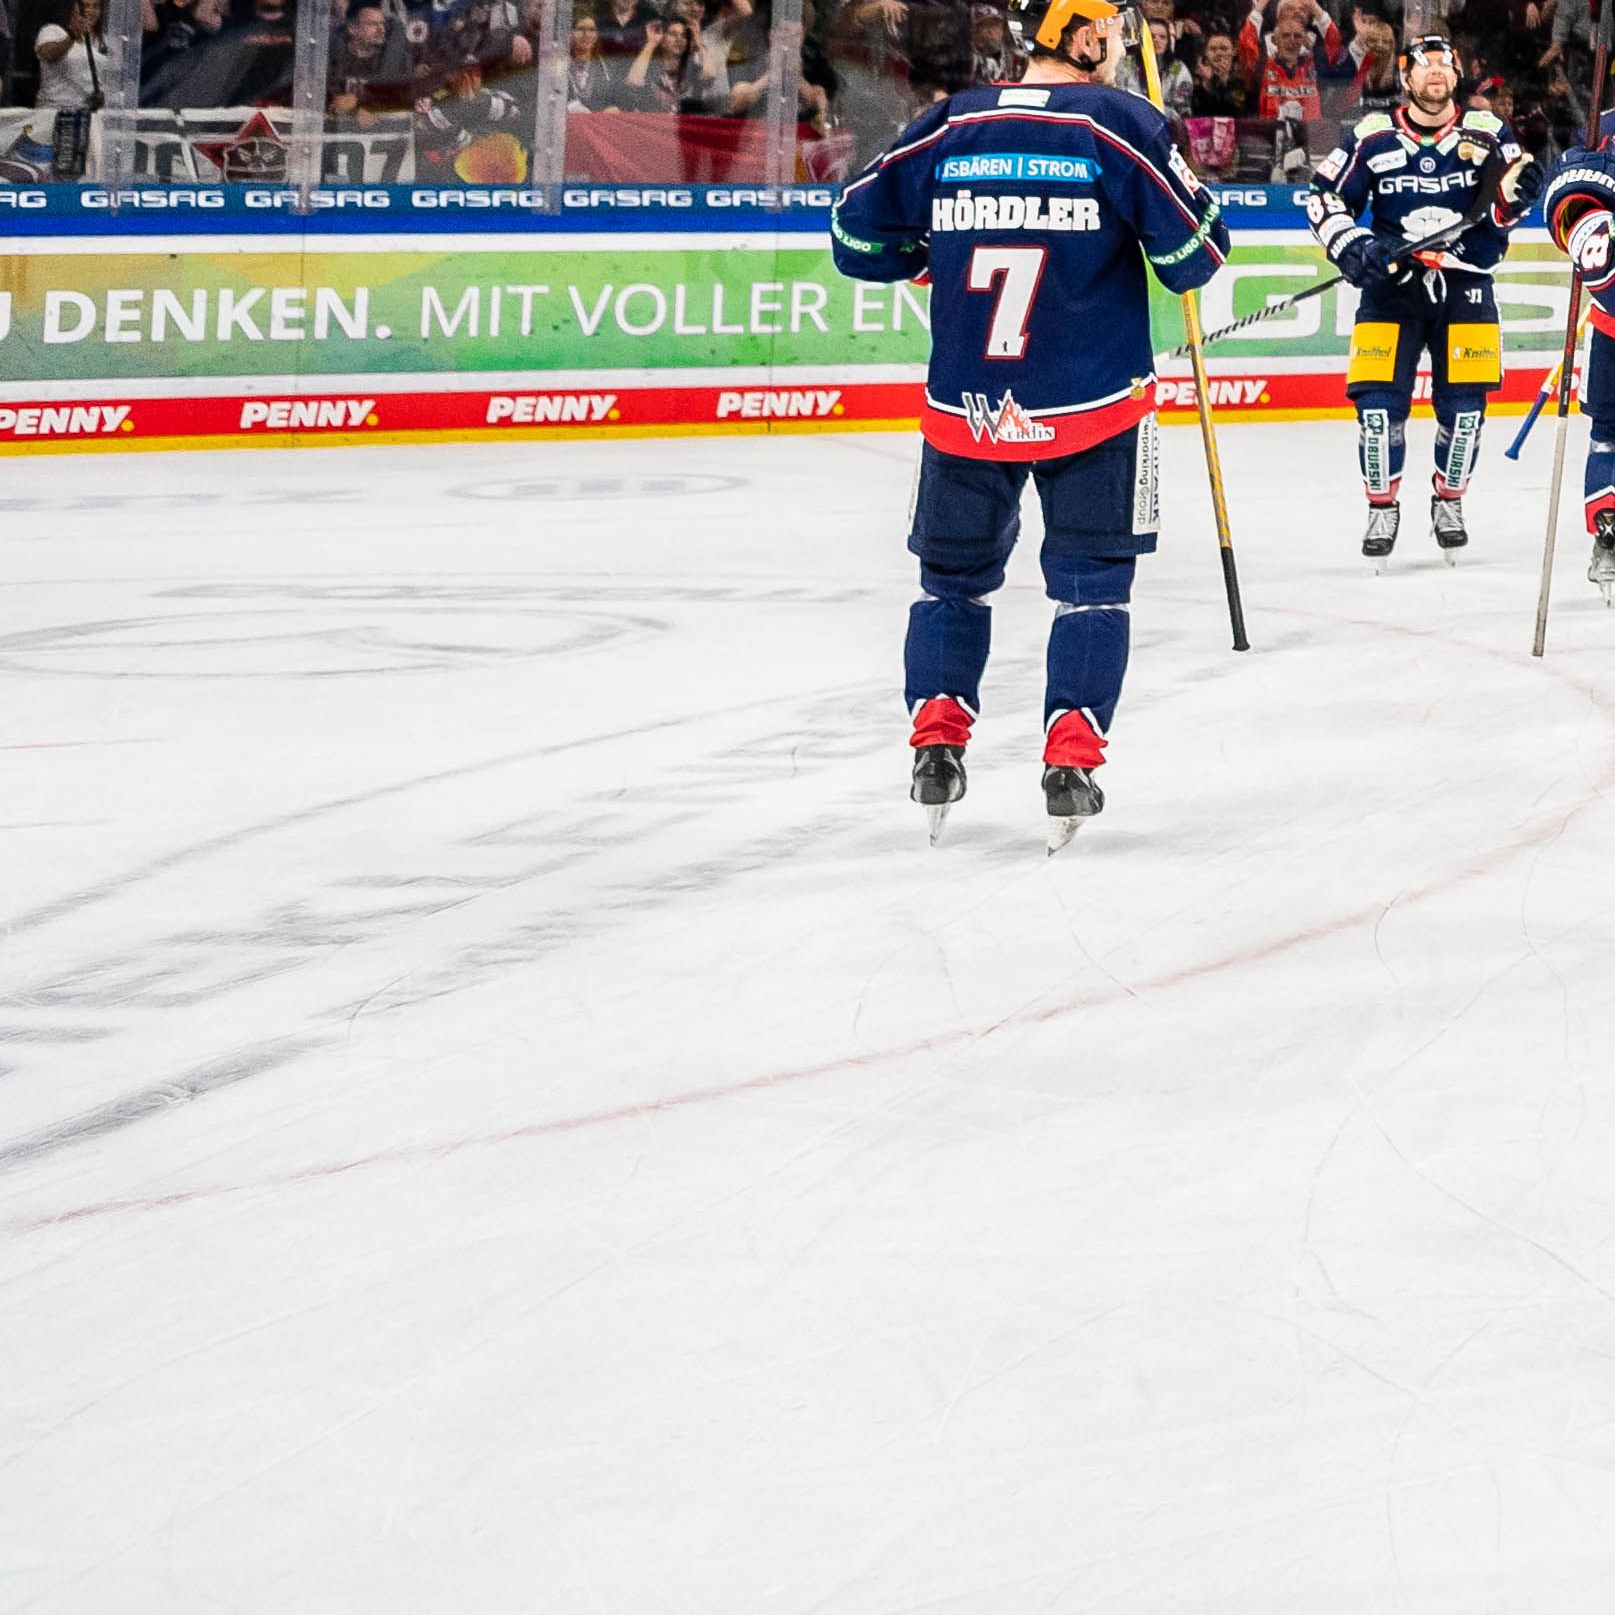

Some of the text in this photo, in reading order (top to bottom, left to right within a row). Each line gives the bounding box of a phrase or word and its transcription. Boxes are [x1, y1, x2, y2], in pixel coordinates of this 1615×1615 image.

[1027, 160, 1088, 180] STROM
[81, 188, 833, 210] GASAG GASAG GASAG GASAG GASAG
[933, 189, 1101, 231] HÖRDLER
[1209, 190, 1267, 207] SAG
[44, 286, 391, 345] DENKEN.
[421, 285, 549, 340] MIT
[568, 280, 828, 338] VOLLER
[968, 245, 1048, 360] 7
[241, 398, 379, 429] PENNY.
[487, 394, 621, 424] PENNY.
[716, 389, 844, 418] PENNY.
